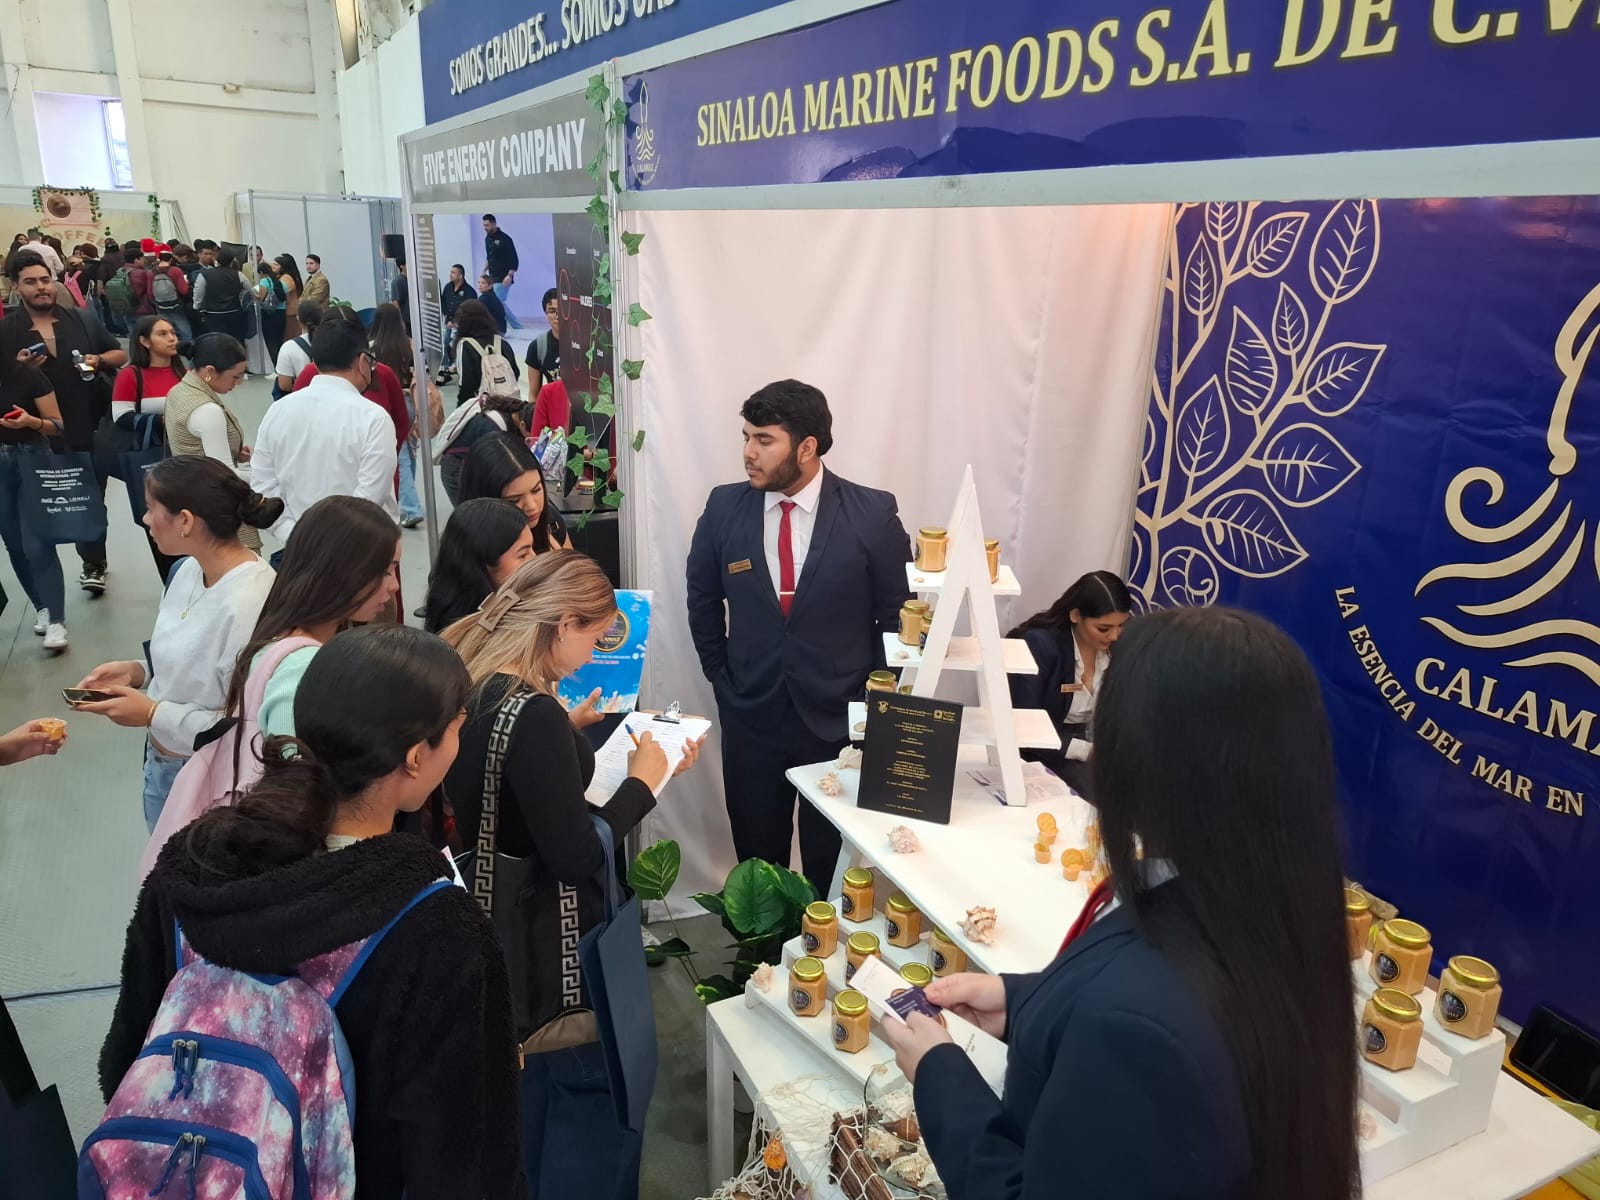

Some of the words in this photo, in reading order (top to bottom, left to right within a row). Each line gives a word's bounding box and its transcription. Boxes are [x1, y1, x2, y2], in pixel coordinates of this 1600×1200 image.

[449, 44, 485, 96] SOMOS
[485, 12, 560, 81] GRANDES...
[697, 87, 797, 147] SINALOA
[802, 56, 939, 133] MARINE
[945, 19, 1120, 113] FOODS
[1129, 0, 1251, 87] S.A.
[1273, 0, 1398, 67] DE
[422, 150, 447, 186] FIVE
[447, 139, 496, 184] ENERGY
[499, 117, 586, 179] COMPANY
[1335, 585, 1361, 619] LA
[1348, 624, 1417, 722] ESENCIA
[1416, 716, 1464, 765] DEL
[1470, 754, 1533, 803] MAR
[1544, 784, 1585, 817] EN
[1414, 657, 1600, 757] CALAM
